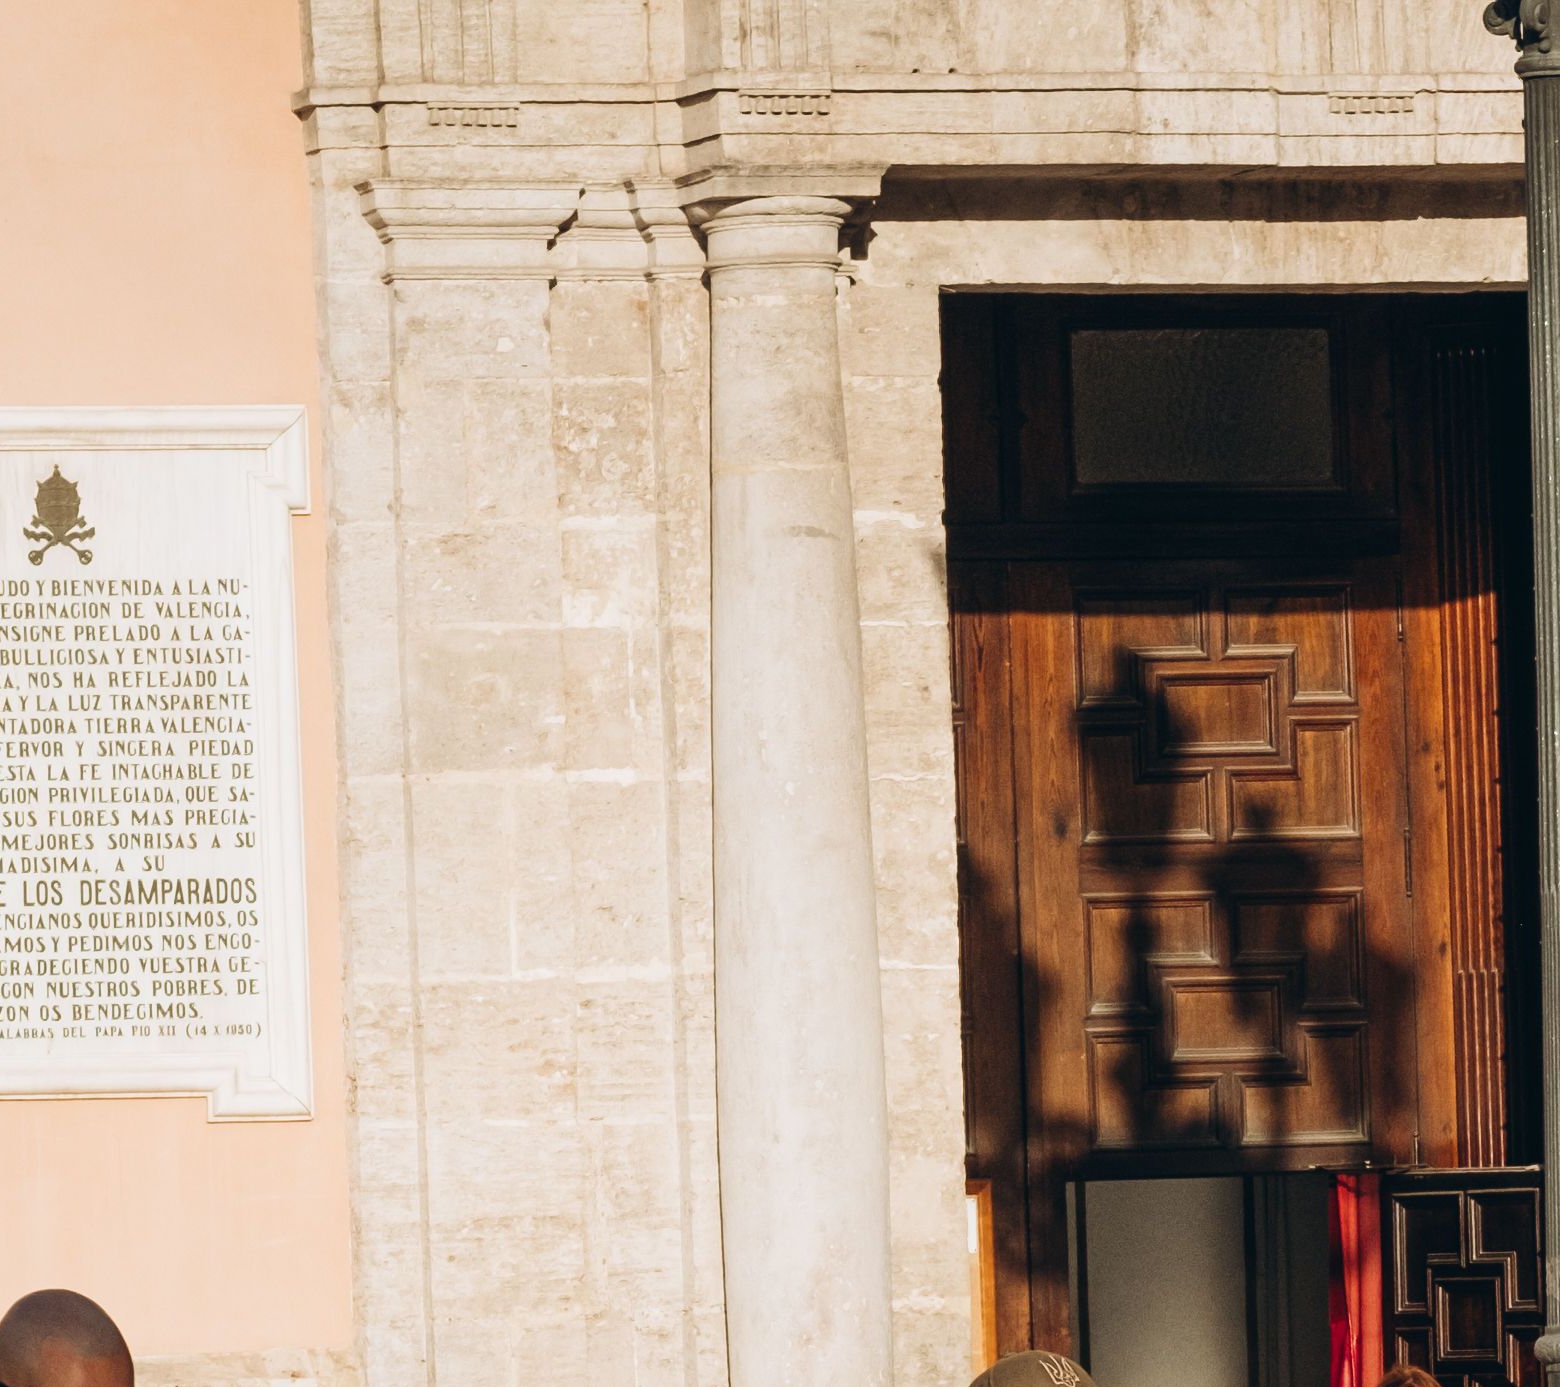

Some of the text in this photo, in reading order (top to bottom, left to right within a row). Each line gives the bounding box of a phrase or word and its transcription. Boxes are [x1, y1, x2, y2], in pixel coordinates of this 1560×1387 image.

[35, 580, 46, 597] Y
[51, 579, 165, 597] BIENVENIDA
[170, 580, 183, 595] A
[188, 579, 212, 595] LA
[217, 579, 249, 595] NU-
[120, 602, 146, 619] DE
[27, 672, 63, 688] NOS
[72, 672, 97, 688] HA
[107, 670, 217, 688] REFLEJADO
[227, 671, 250, 687] LA
[17, 696, 29, 712] Y
[35, 695, 60, 712] LA
[68, 694, 102, 711] LUZ
[108, 693, 253, 711] TRANSPARENTE
[83, 717, 156, 734] TIERRA
[74, 741, 85, 757] Y
[188, 740, 254, 756] PIEDAD
[47, 764, 70, 781] LA
[79, 764, 102, 781] FE
[231, 763, 255, 779] DE
[47, 786, 180, 804] PRIVILEGIADA,
[184, 786, 220, 804] QUE
[227, 786, 256, 802] SA-
[1, 811, 38, 827] SUS
[47, 810, 120, 827] FLORES
[130, 809, 174, 826] MAS
[0, 833, 95, 851] MEJORES
[106, 833, 198, 850] SONRISAS
[210, 834, 221, 848] A
[234, 832, 256, 848] SU
[114, 856, 126, 872] A
[141, 855, 165, 872] SU
[22, 880, 64, 907] LOS
[77, 878, 257, 906] DESAMPARADOS
[50, 936, 60, 952] Y
[67, 935, 154, 952] PEDIMOS
[161, 935, 197, 951] NOS
[46, 981, 141, 998] NUESTROS
[151, 981, 228, 997] POBRES,
[236, 980, 260, 995] DE
[39, 1005, 62, 1021] OS
